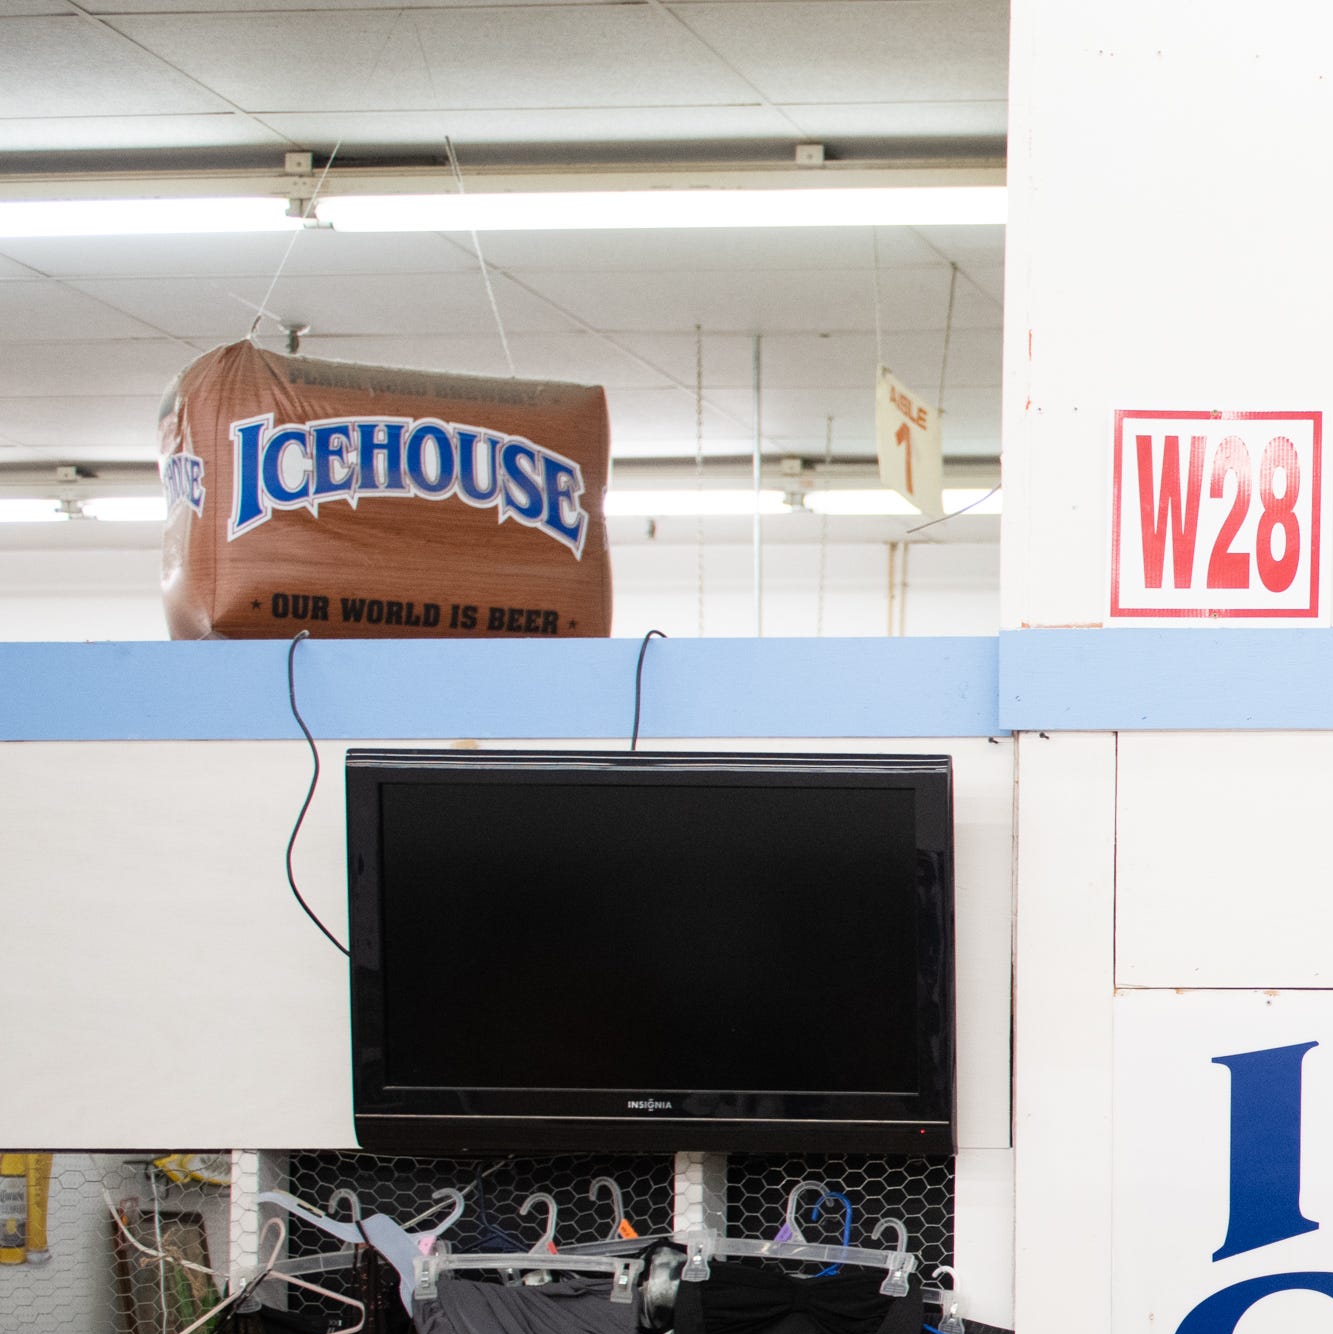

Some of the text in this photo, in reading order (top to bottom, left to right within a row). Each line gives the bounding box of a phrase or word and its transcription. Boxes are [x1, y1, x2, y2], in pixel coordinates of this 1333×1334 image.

[229, 412, 588, 560] ICEHOUSE
[895, 421, 914, 496] 1
[1136, 435, 1300, 592] W28
[271, 592, 560, 635] OUR WORLD IS BEER
[627, 1098, 673, 1112] INSIGNIA
